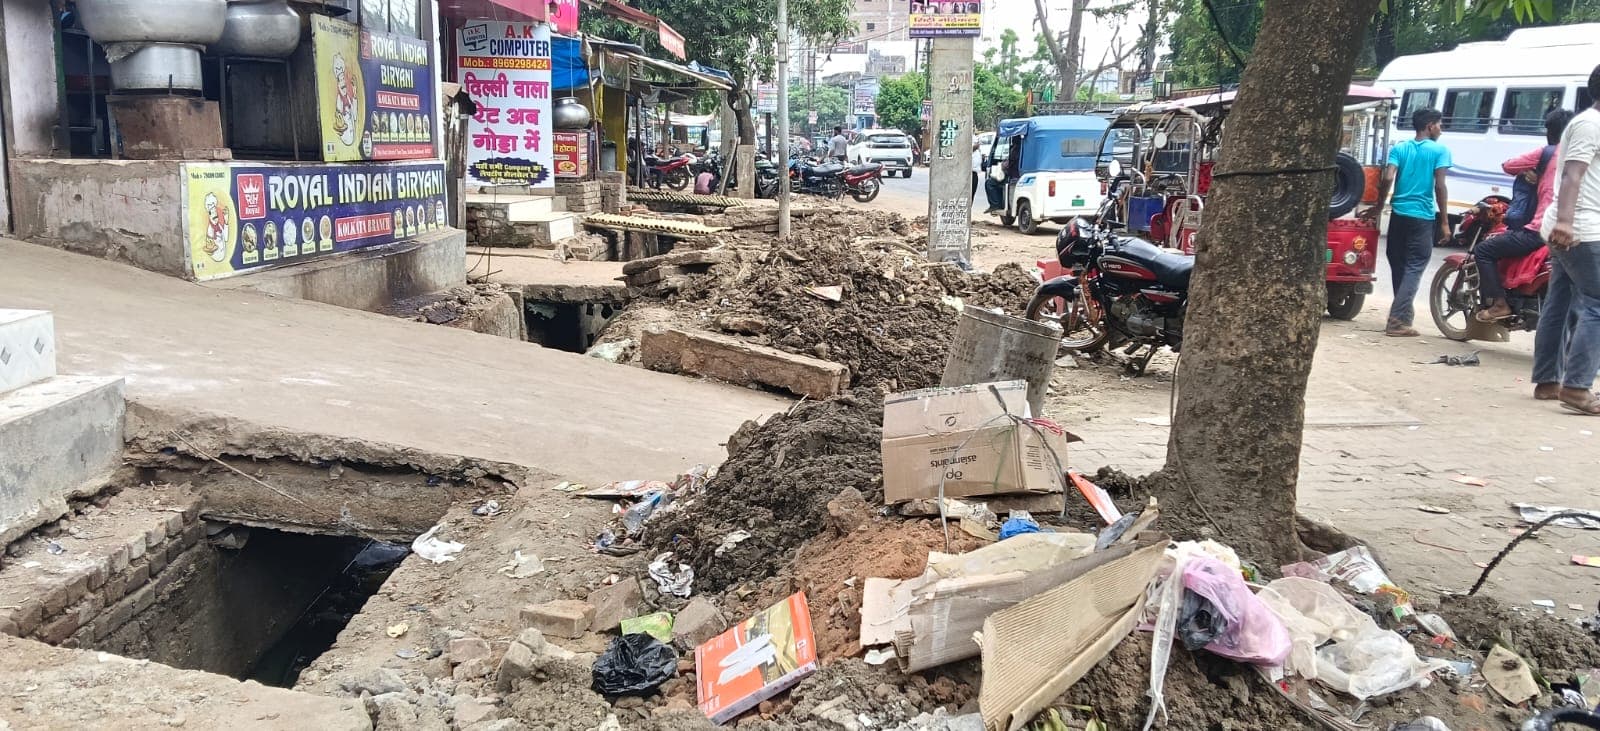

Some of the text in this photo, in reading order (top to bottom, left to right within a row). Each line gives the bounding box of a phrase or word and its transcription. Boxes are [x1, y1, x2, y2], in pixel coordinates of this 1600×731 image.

[505, 25, 533, 38] A.K
[370, 35, 428, 66] ROYAL INDIAN
[490, 39, 549, 56] COMPUTER
[492, 58, 548, 69] 8969298424
[380, 64, 414, 88] BIRYANI
[464, 72, 549, 98] दिल्ली वाला
[472, 100, 540, 125] रेट अब
[472, 128, 541, 153] गोड्डा में
[269, 170, 444, 212] ROYAL INDIAN BIRYANI
[337, 217, 391, 237] KOLKATA BRANCH
